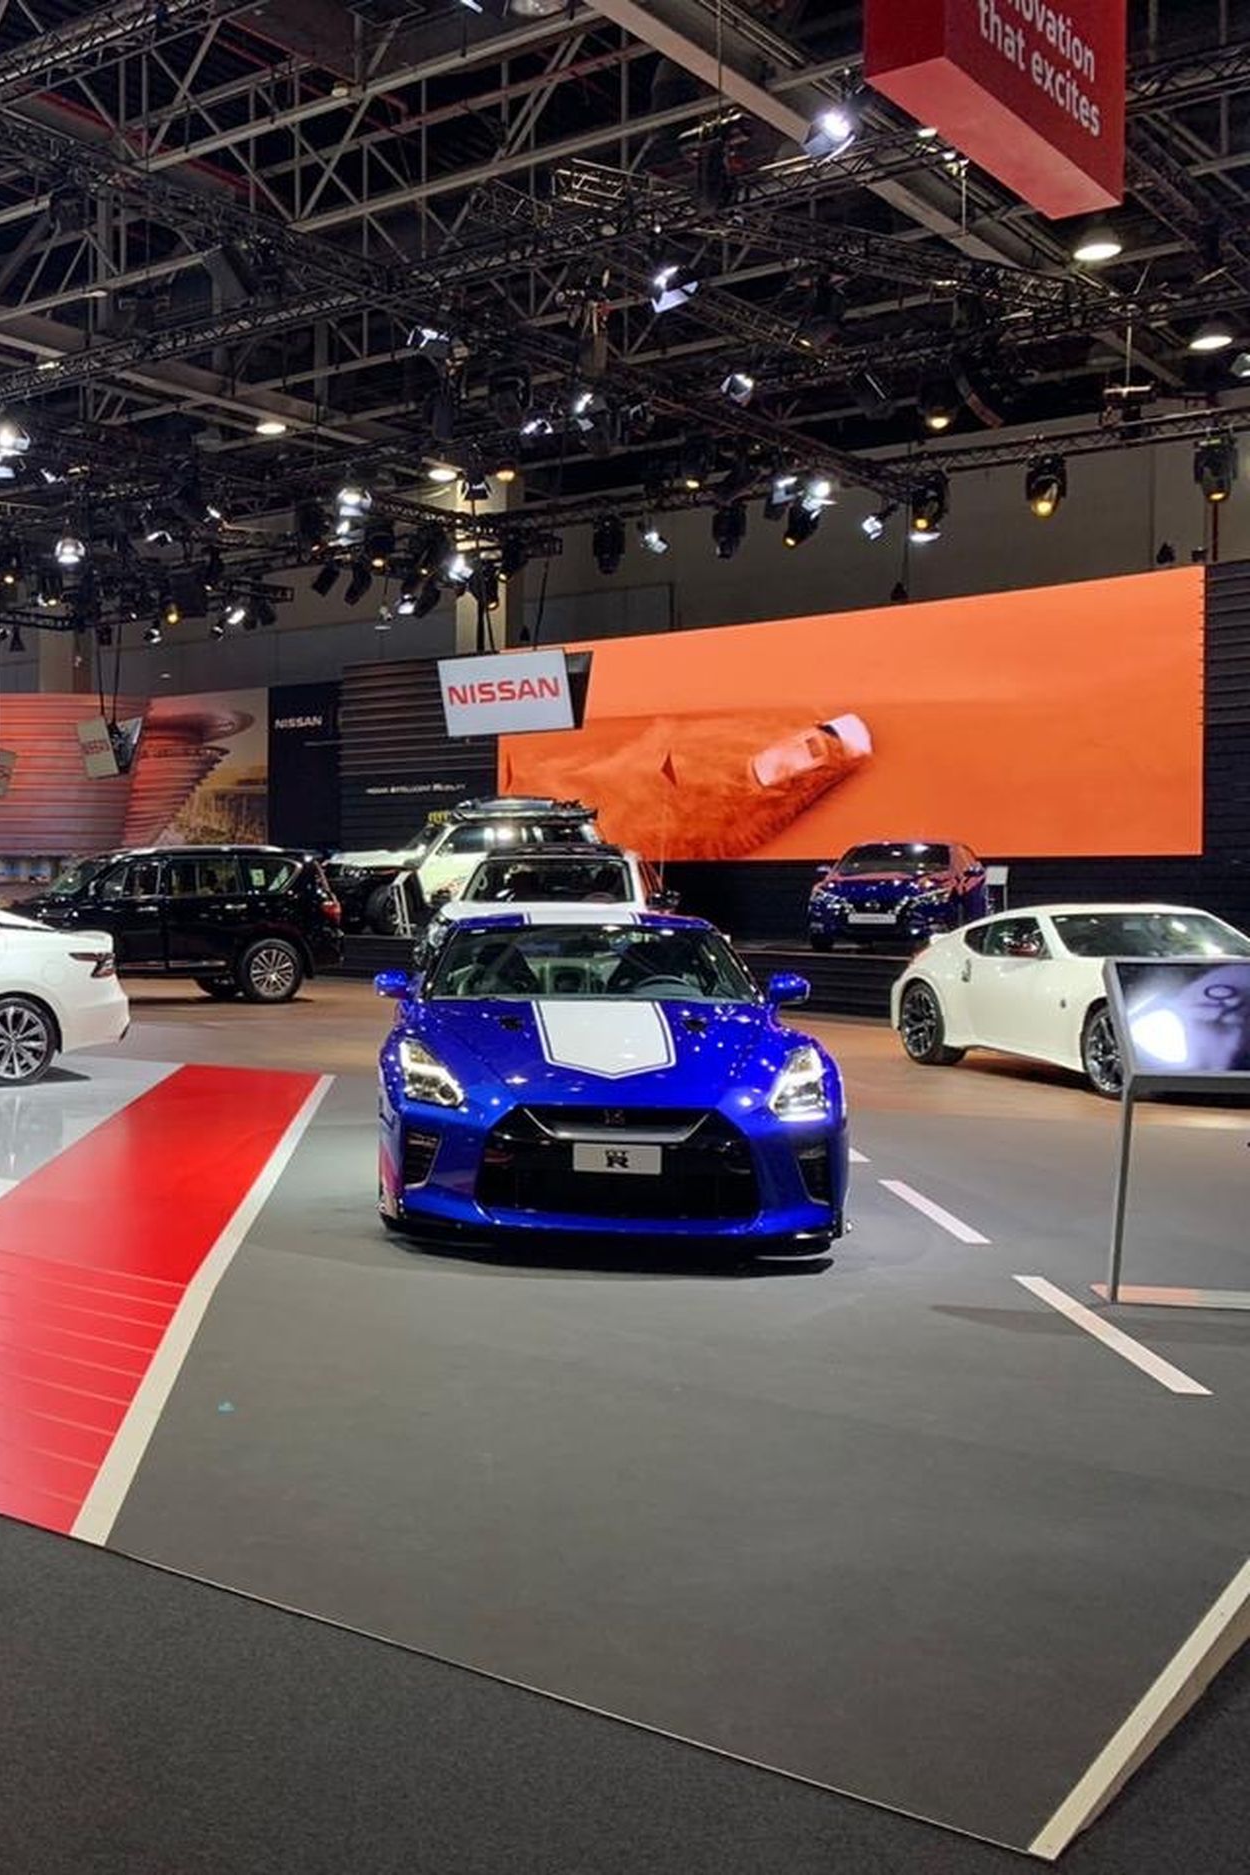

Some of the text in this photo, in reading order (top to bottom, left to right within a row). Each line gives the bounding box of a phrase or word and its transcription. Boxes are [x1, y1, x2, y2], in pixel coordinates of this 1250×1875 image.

[979, 0, 1100, 137] that excites
[447, 676, 561, 706] NISSAN
[274, 715, 323, 730] NISSAN
